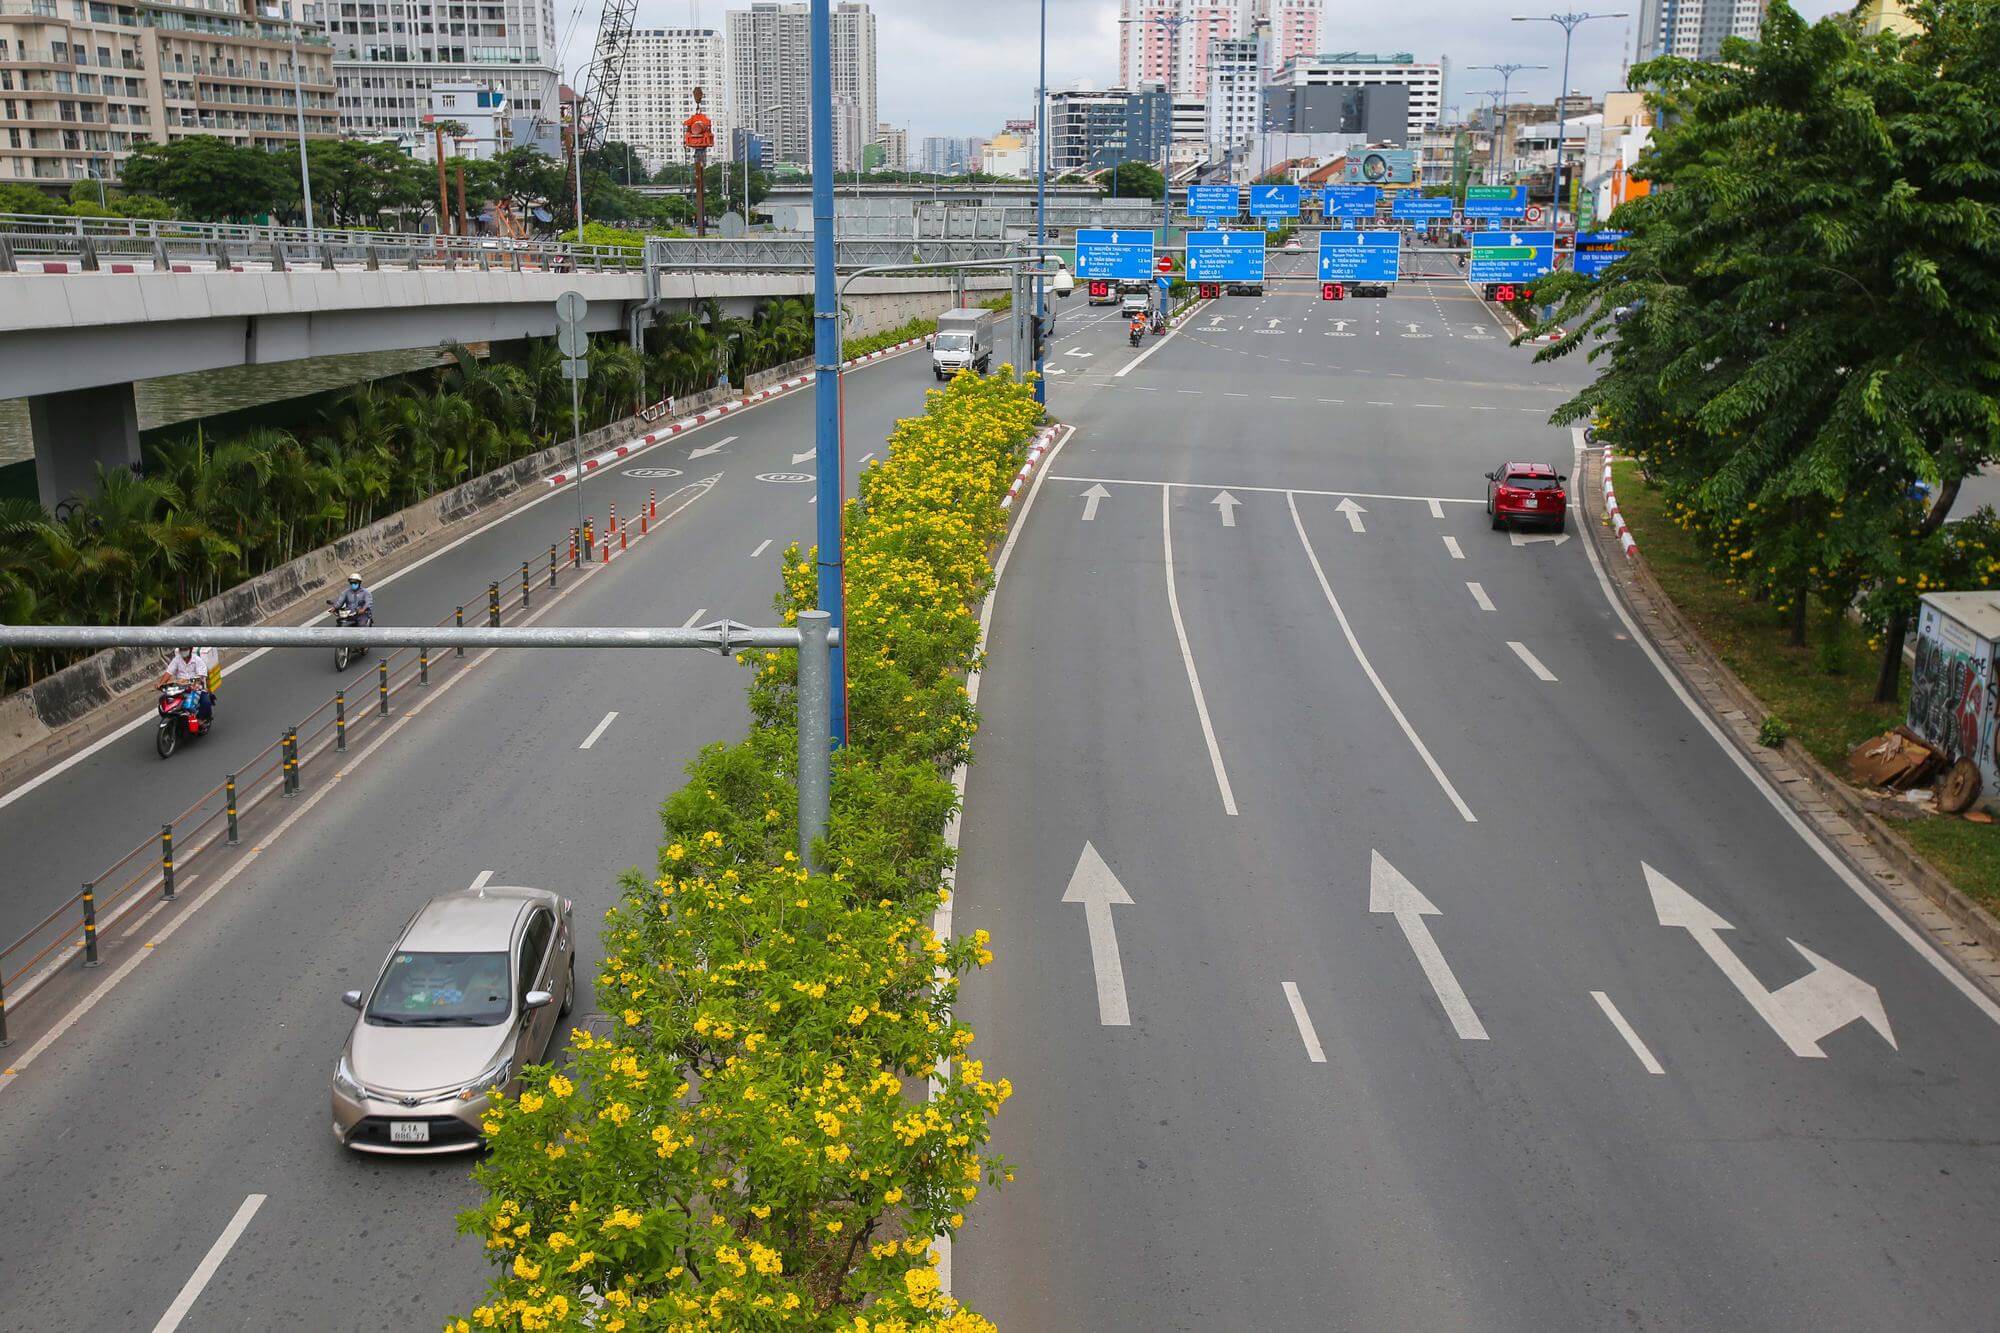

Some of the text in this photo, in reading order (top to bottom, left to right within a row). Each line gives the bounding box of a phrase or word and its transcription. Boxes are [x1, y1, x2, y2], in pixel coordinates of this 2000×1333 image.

[1091, 283, 1107, 295] 66
[1202, 286, 1219, 298] 67
[1324, 285, 1343, 299] 67
[1496, 286, 1515, 300] 26
